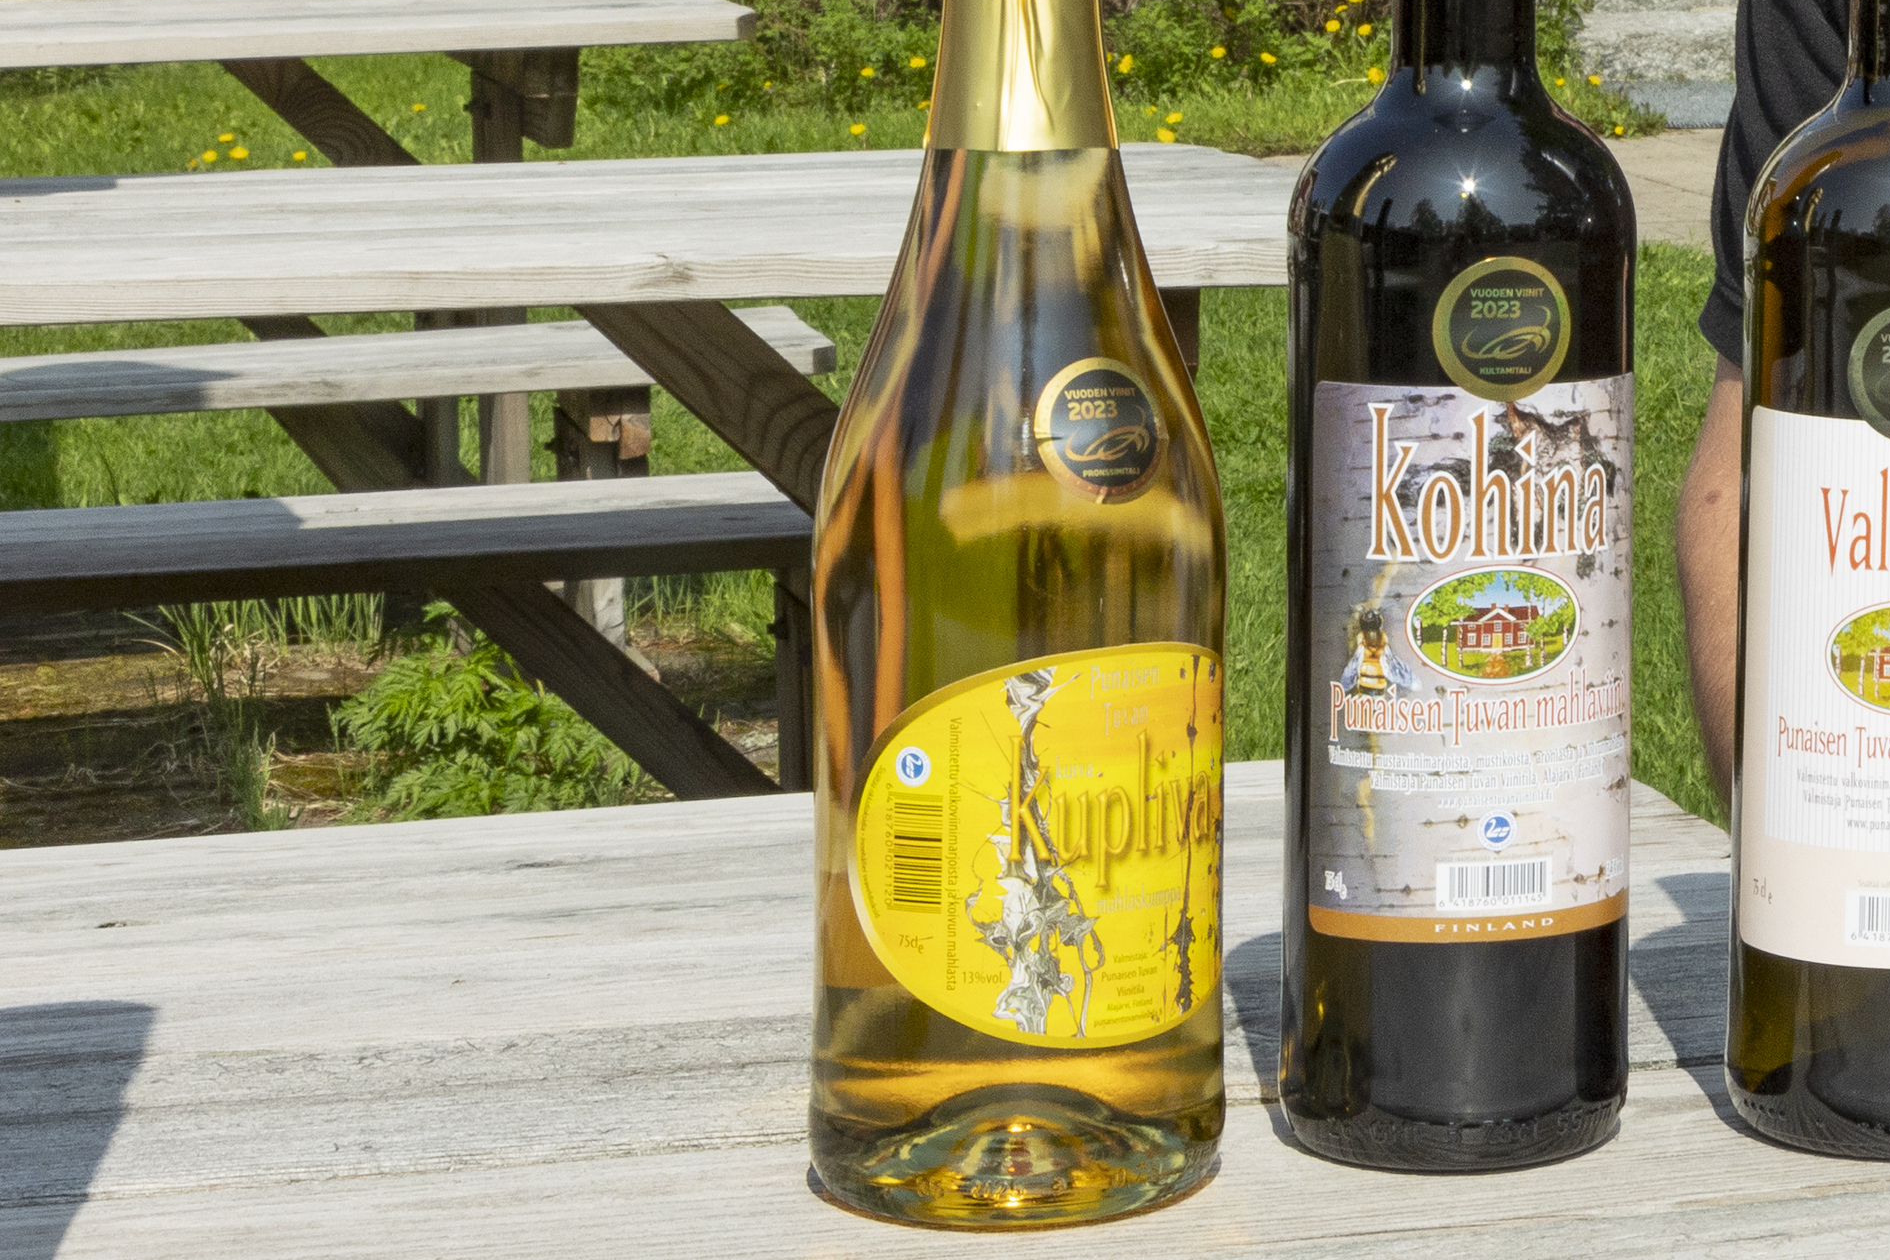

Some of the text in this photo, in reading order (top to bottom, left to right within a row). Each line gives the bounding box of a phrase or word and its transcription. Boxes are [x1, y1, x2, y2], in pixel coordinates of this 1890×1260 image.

[1470, 287, 1545, 298] VUODEN VIINIT
[1470, 300, 1521, 319] 2023
[1064, 387, 1108, 400] VUODEN
[1067, 400, 1118, 421] 2023
[1090, 662, 1160, 700] Punaisen
[1329, 681, 1445, 742] Punaisen
[1448, 688, 1529, 748] Tuvan
[1534, 665, 1626, 730] mahlaviini
[1103, 702, 1149, 736] Tuvan
[1777, 715, 1847, 758] Punaisen
[1055, 754, 1094, 779] kuiva
[1475, 750, 1533, 771] mustikoista,
[1369, 770, 1417, 795] Valmistaja
[1420, 773, 1466, 792] Punaisen
[1468, 773, 1499, 791] Tuvan
[1797, 767, 1838, 786] Valmistettu
[1803, 787, 1842, 810] Valmistaja
[1845, 795, 1883, 812] Punaisen
[945, 717, 963, 992] Valmistettu valkoviinimarjoista ja koivun mahlasta
[1438, 895, 1544, 908] 6 418760 011145
[1435, 918, 1554, 933] FINLAND
[1850, 932, 1858, 941] 6
[1101, 966, 1158, 982] Punaisen Tuvan
[1116, 984, 1145, 997] Viinitila
